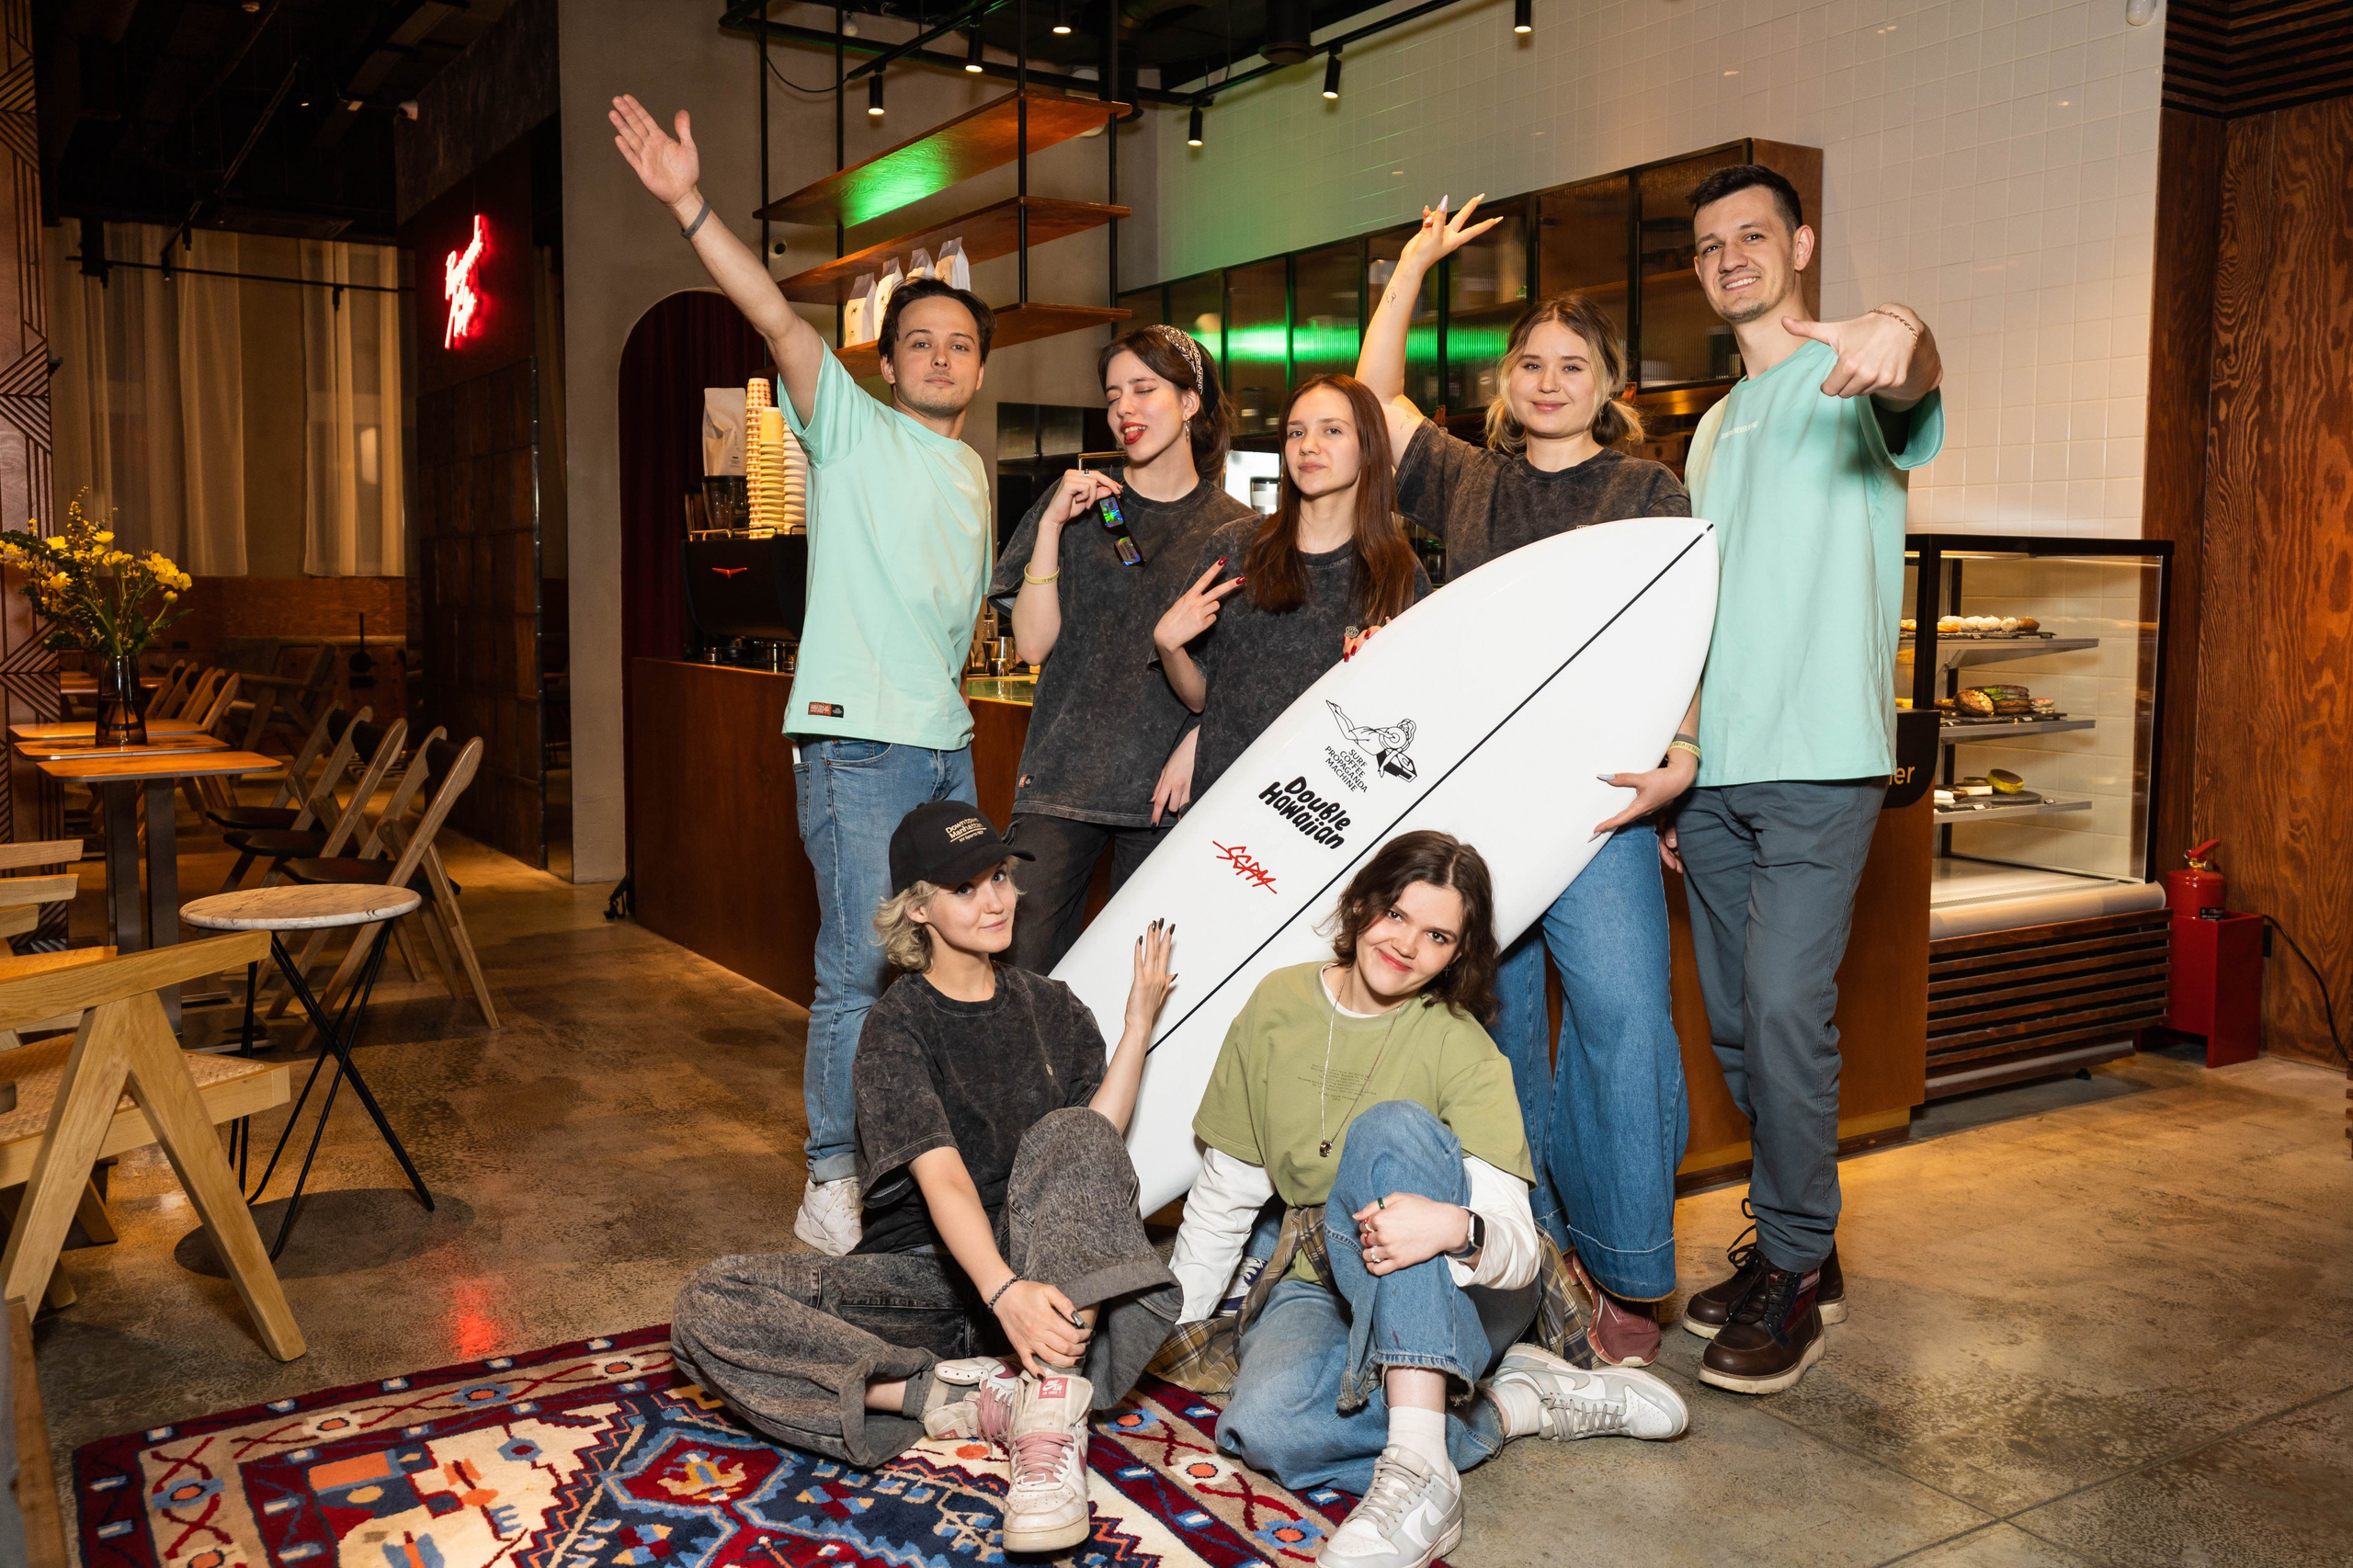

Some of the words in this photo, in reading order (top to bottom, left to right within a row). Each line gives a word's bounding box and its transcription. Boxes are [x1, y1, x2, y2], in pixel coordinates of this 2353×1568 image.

[1324, 745, 1368, 793] PROPAGANDA
[1324, 757, 1358, 792] MACHINE
[1340, 751, 1366, 778] COFFEE
[1348, 749, 1368, 767] SURF
[1258, 781, 1345, 849] Hawaiian
